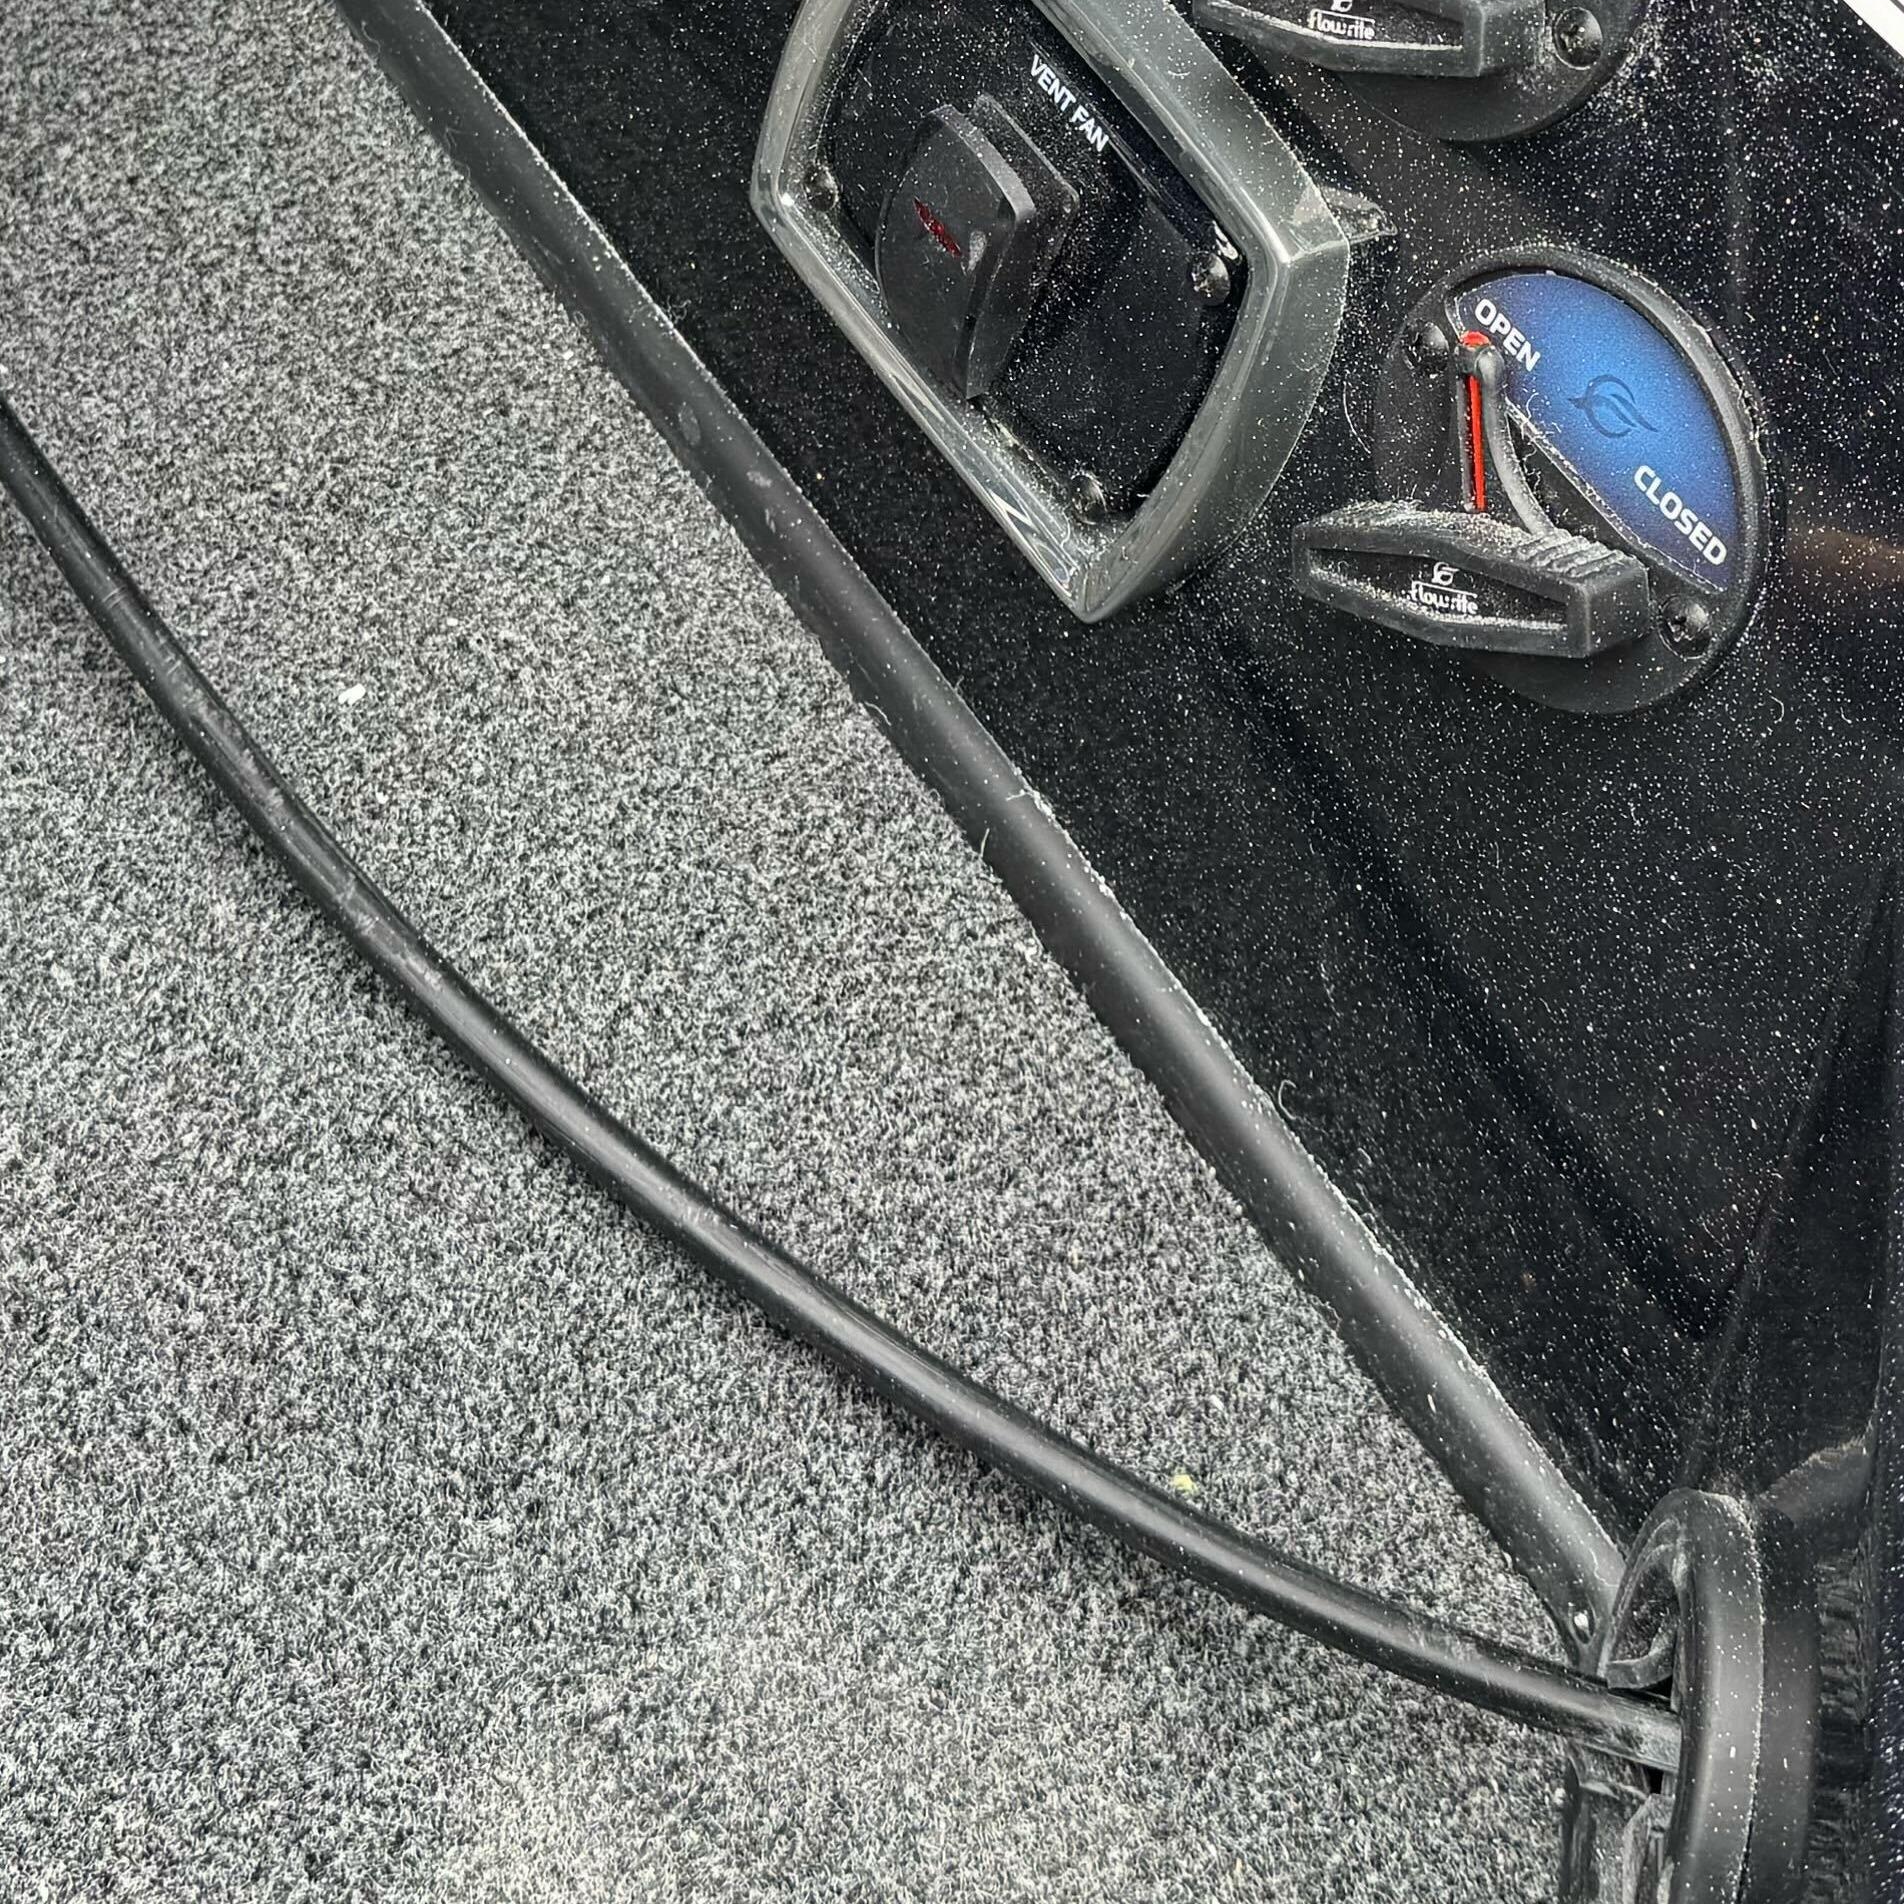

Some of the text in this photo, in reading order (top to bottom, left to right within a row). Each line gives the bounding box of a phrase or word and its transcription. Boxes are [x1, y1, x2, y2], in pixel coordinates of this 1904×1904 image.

[1030, 54, 1110, 152] VENT FAN
[1474, 299, 1541, 373] OPEN
[1634, 465, 1727, 567] CLOSED
